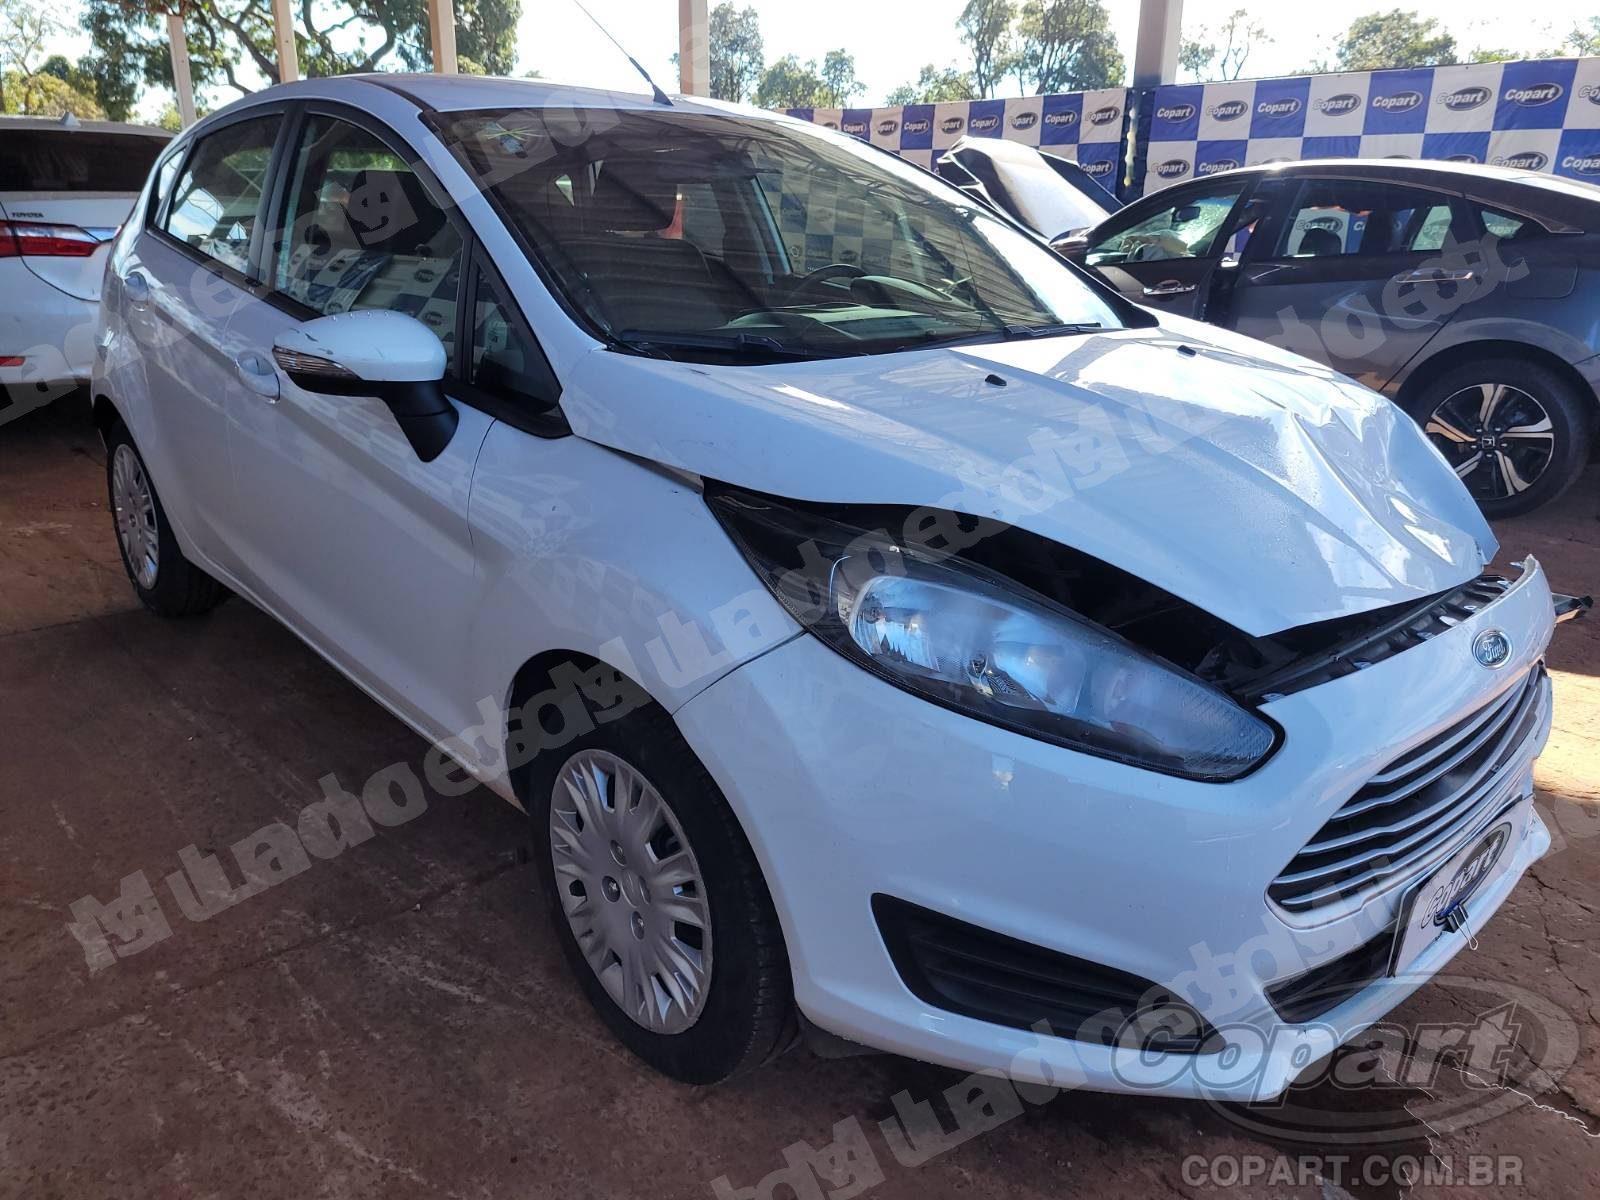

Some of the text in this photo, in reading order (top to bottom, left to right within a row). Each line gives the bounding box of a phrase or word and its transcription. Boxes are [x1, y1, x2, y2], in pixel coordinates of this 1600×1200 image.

[1372, 94, 1417, 109] Copart
[1436, 90, 1485, 107] Copart
[1504, 86, 1556, 104] Copart
[1206, 104, 1242, 117] Copart
[1257, 101, 1297, 114] Copart
[1312, 98, 1354, 111] Copart
[1045, 113, 1074, 126] Copart
[1156, 107, 1192, 119] Copart
[904, 121, 928, 132] Copart
[970, 118, 996, 129] Copart
[1562, 156, 1600, 171] Copa
